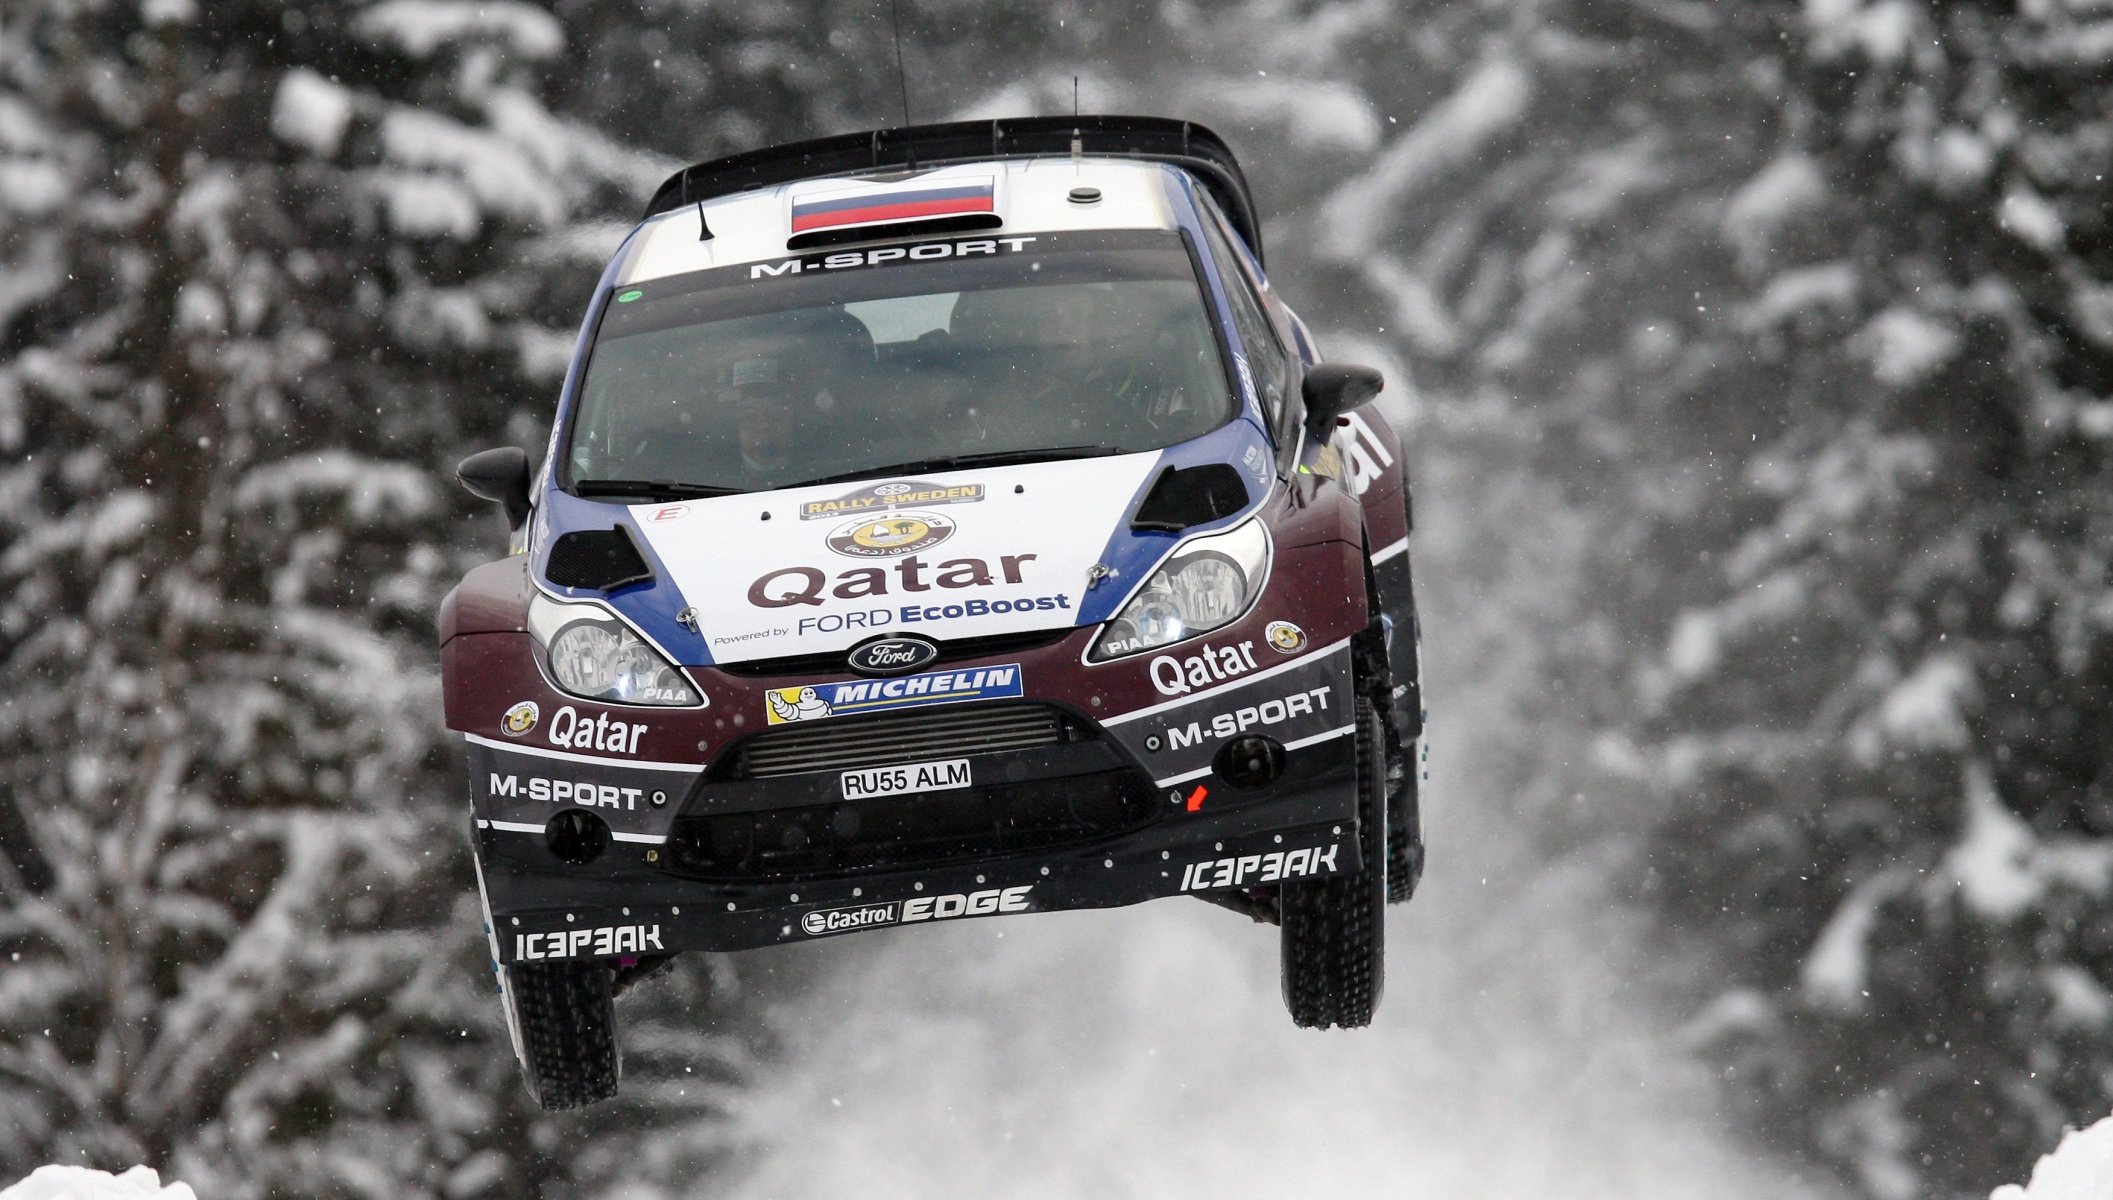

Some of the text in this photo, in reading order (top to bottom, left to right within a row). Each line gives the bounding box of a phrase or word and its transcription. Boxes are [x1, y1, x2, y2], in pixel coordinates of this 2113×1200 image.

[750, 237, 1037, 279] M-SPORT
[654, 507, 682, 521] E
[808, 497, 876, 514] RALLY
[883, 486, 977, 504] SWEDEN
[747, 553, 1038, 608] Qatar
[714, 593, 1071, 646] Powered by FORD EcoBoost
[868, 643, 916, 666] Ford
[1107, 634, 1156, 654] PIAA
[833, 668, 1015, 705] MICHELIN
[1150, 640, 1258, 696] Qatar
[643, 688, 687, 702] PIAA
[548, 705, 648, 754] Qatar
[1167, 686, 1331, 751] M-SPORT
[490, 772, 642, 811] M-SPORT
[844, 763, 969, 795] RU55 ALM
[827, 885, 1034, 930] Castrol EDGE
